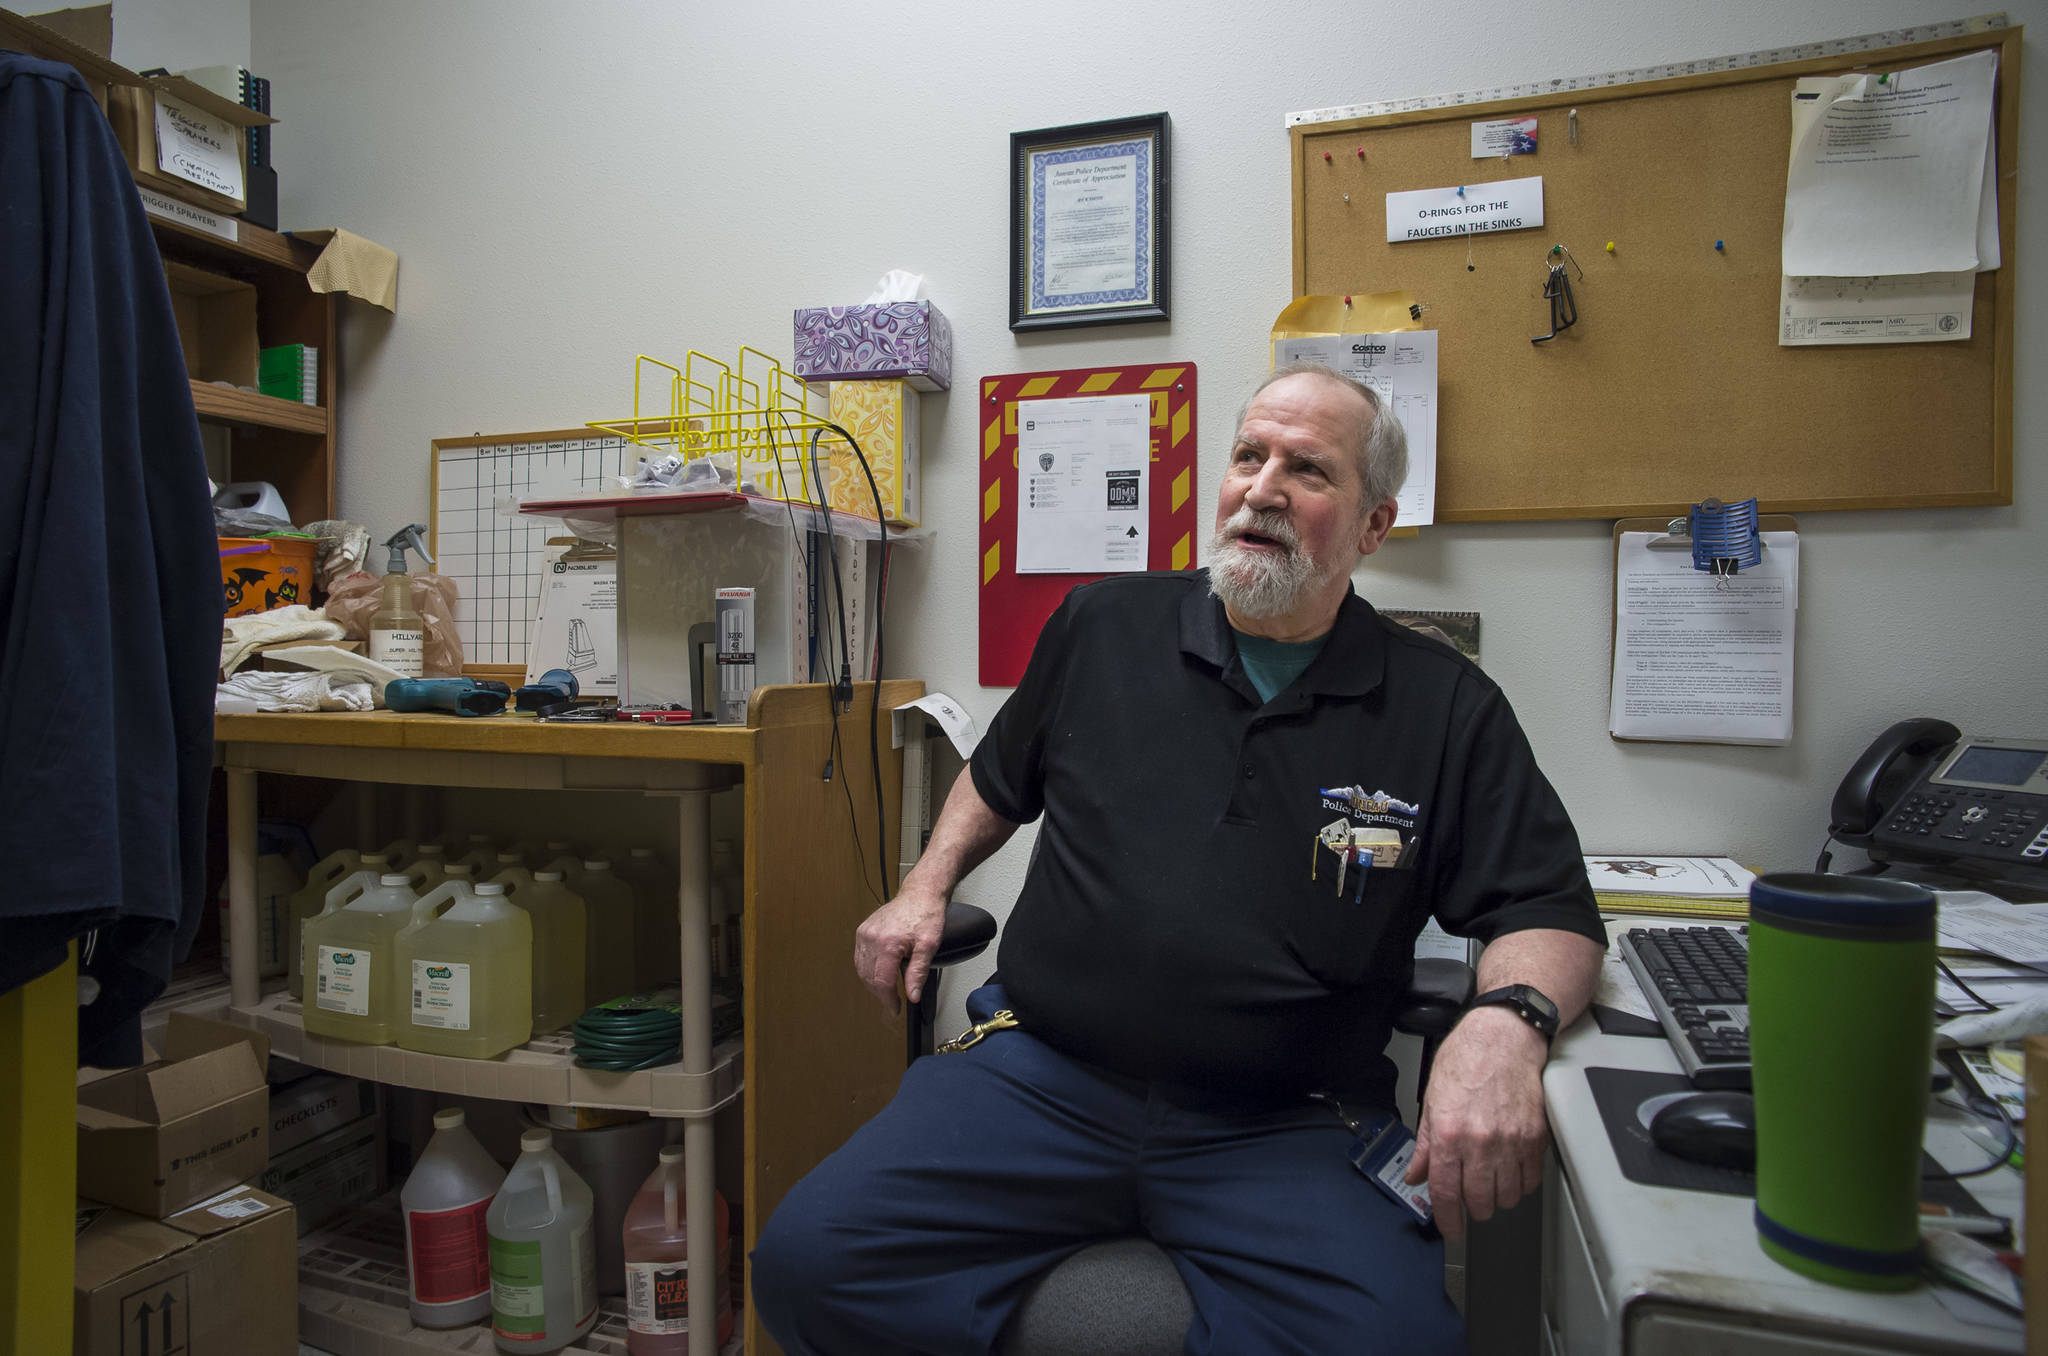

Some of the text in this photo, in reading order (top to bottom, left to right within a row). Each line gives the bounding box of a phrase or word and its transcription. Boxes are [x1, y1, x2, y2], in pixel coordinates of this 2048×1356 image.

[162, 104, 208, 132] TRIGGER
[171, 122, 221, 150] SPRAYERS
[176, 207, 216, 227] SPRAYERS
[1418, 200, 1508, 218] O-RINGS FOR THE
[1407, 218, 1522, 238] FAUCETS IN THE SINKS
[1322, 798, 1414, 828] Police Department
[184, 1132, 249, 1165] THIS SIDE UP
